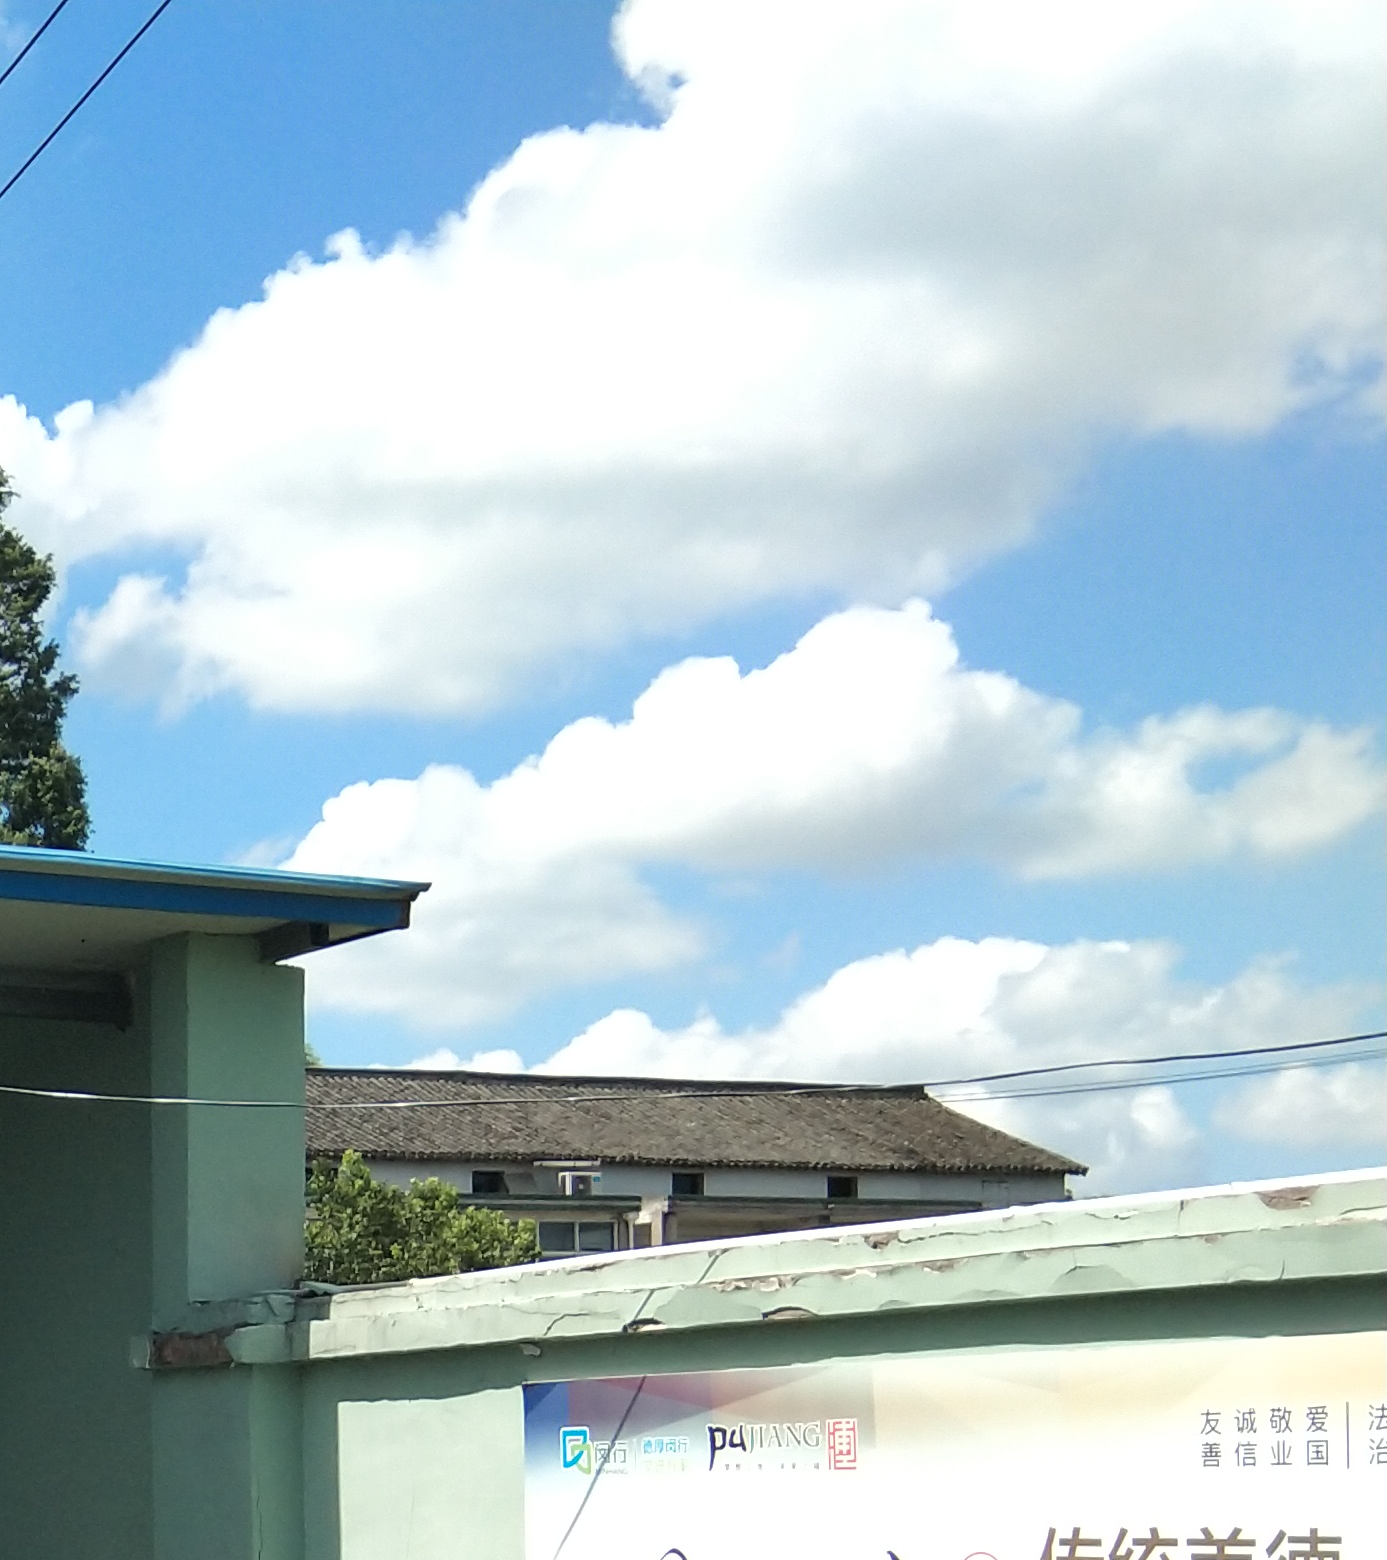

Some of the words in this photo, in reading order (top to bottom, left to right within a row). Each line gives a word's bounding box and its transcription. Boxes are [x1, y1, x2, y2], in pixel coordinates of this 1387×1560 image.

[594, 1442, 628, 1464] 闵行
[1200, 1408, 1222, 1468] 友善
[1234, 1407, 1258, 1467] 诚信
[1269, 1406, 1293, 1466] 敬业
[1306, 1405, 1329, 1466] 爱国
